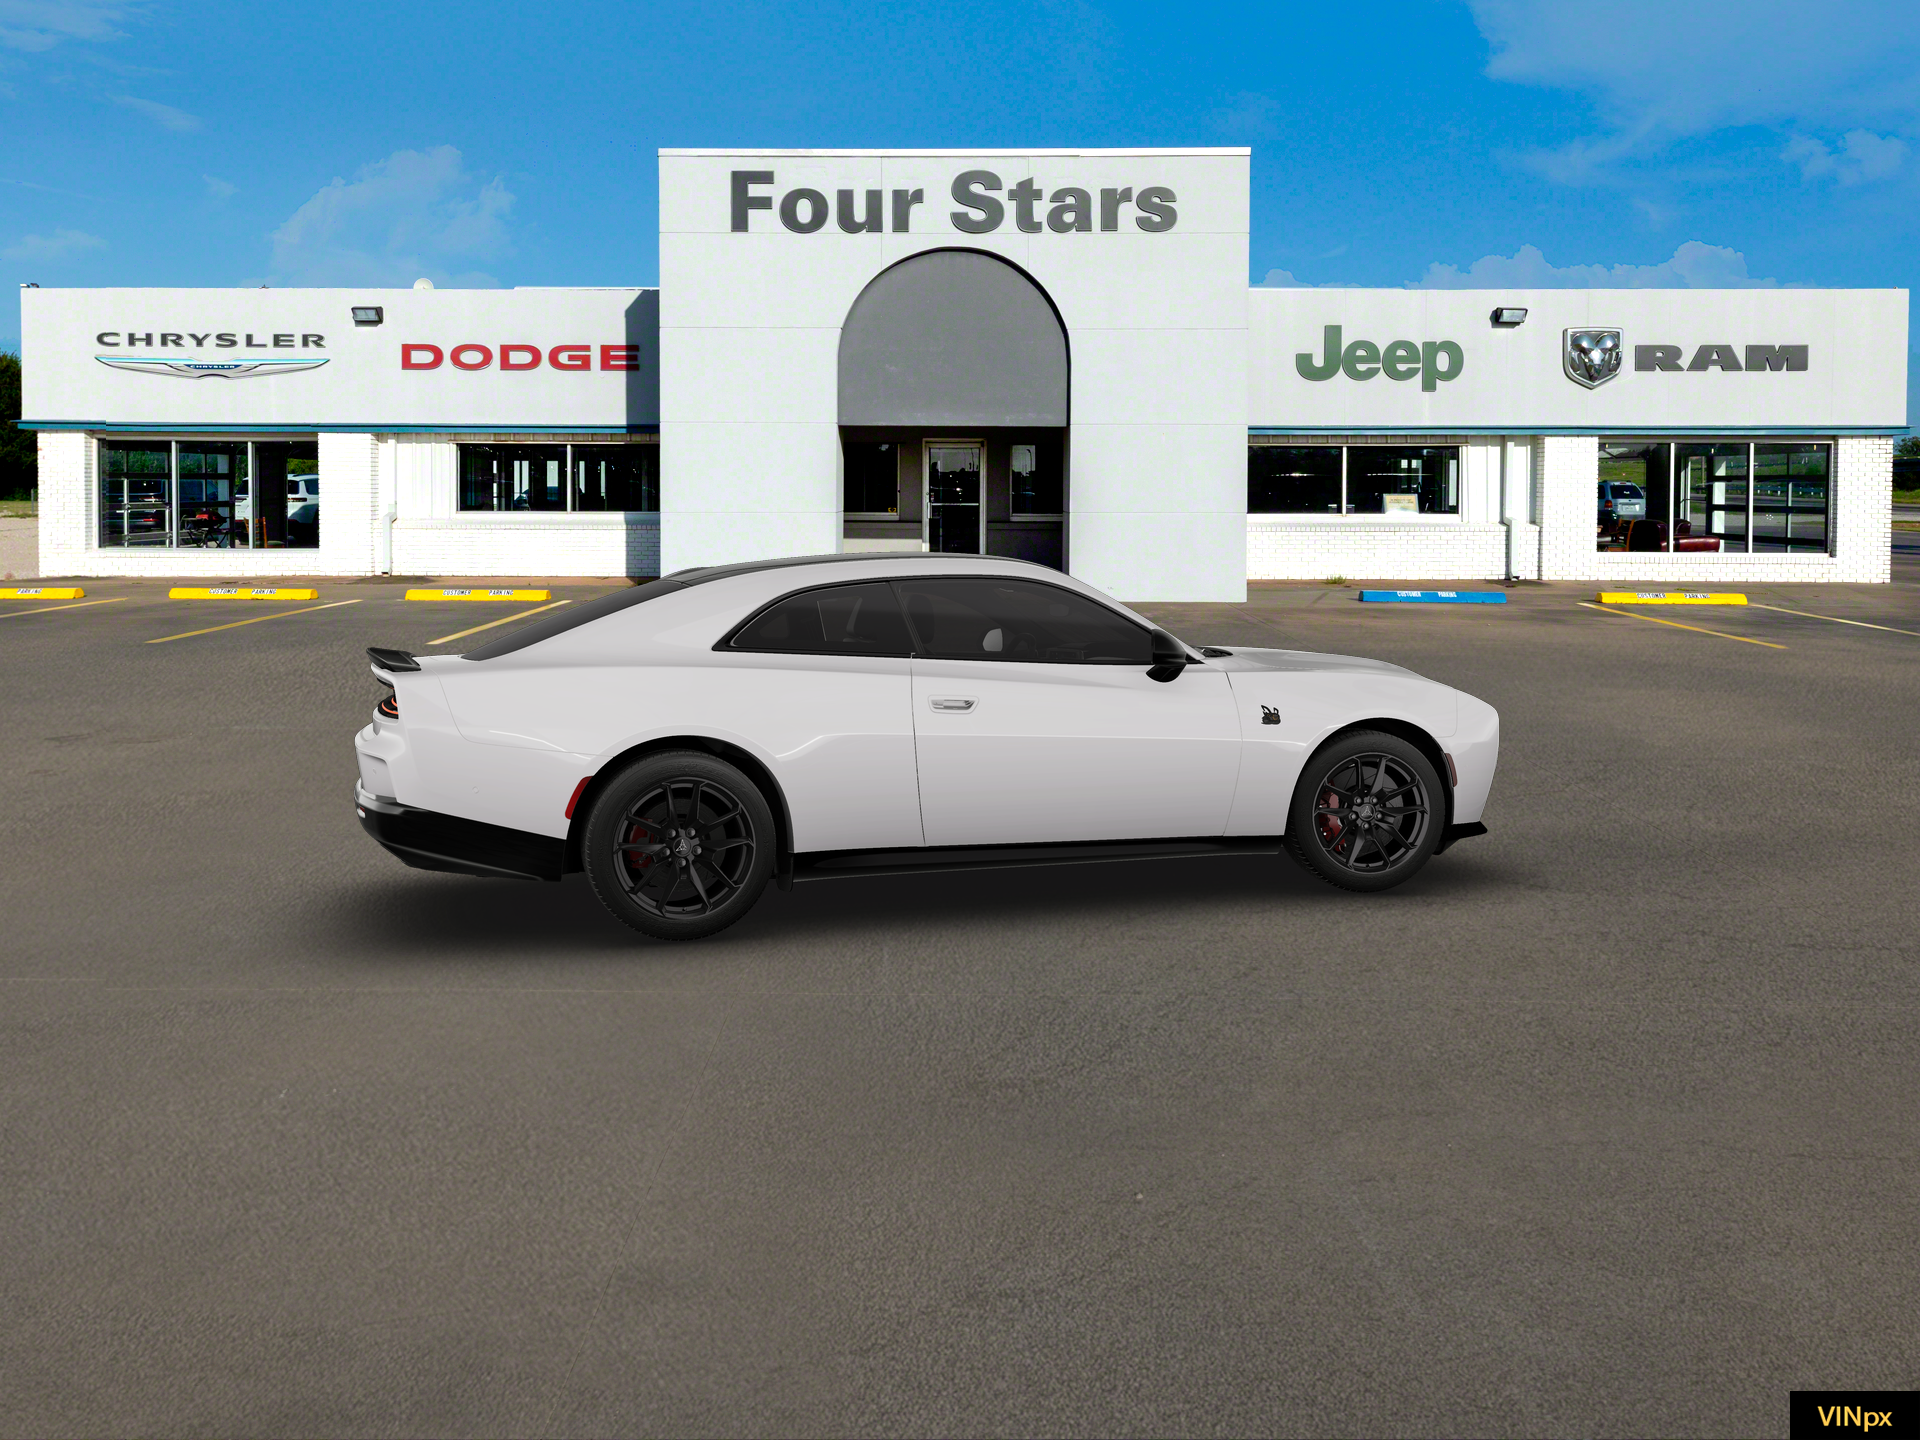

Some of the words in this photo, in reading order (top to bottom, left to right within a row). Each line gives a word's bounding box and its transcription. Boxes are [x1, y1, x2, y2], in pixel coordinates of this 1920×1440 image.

[730, 170, 924, 233] Four
[950, 169, 1178, 233] Stars
[96, 332, 326, 348] CHRYSLER
[401, 344, 640, 371] DODGE
[1295, 325, 1464, 392] Jeep
[1635, 344, 1809, 371] RAM
